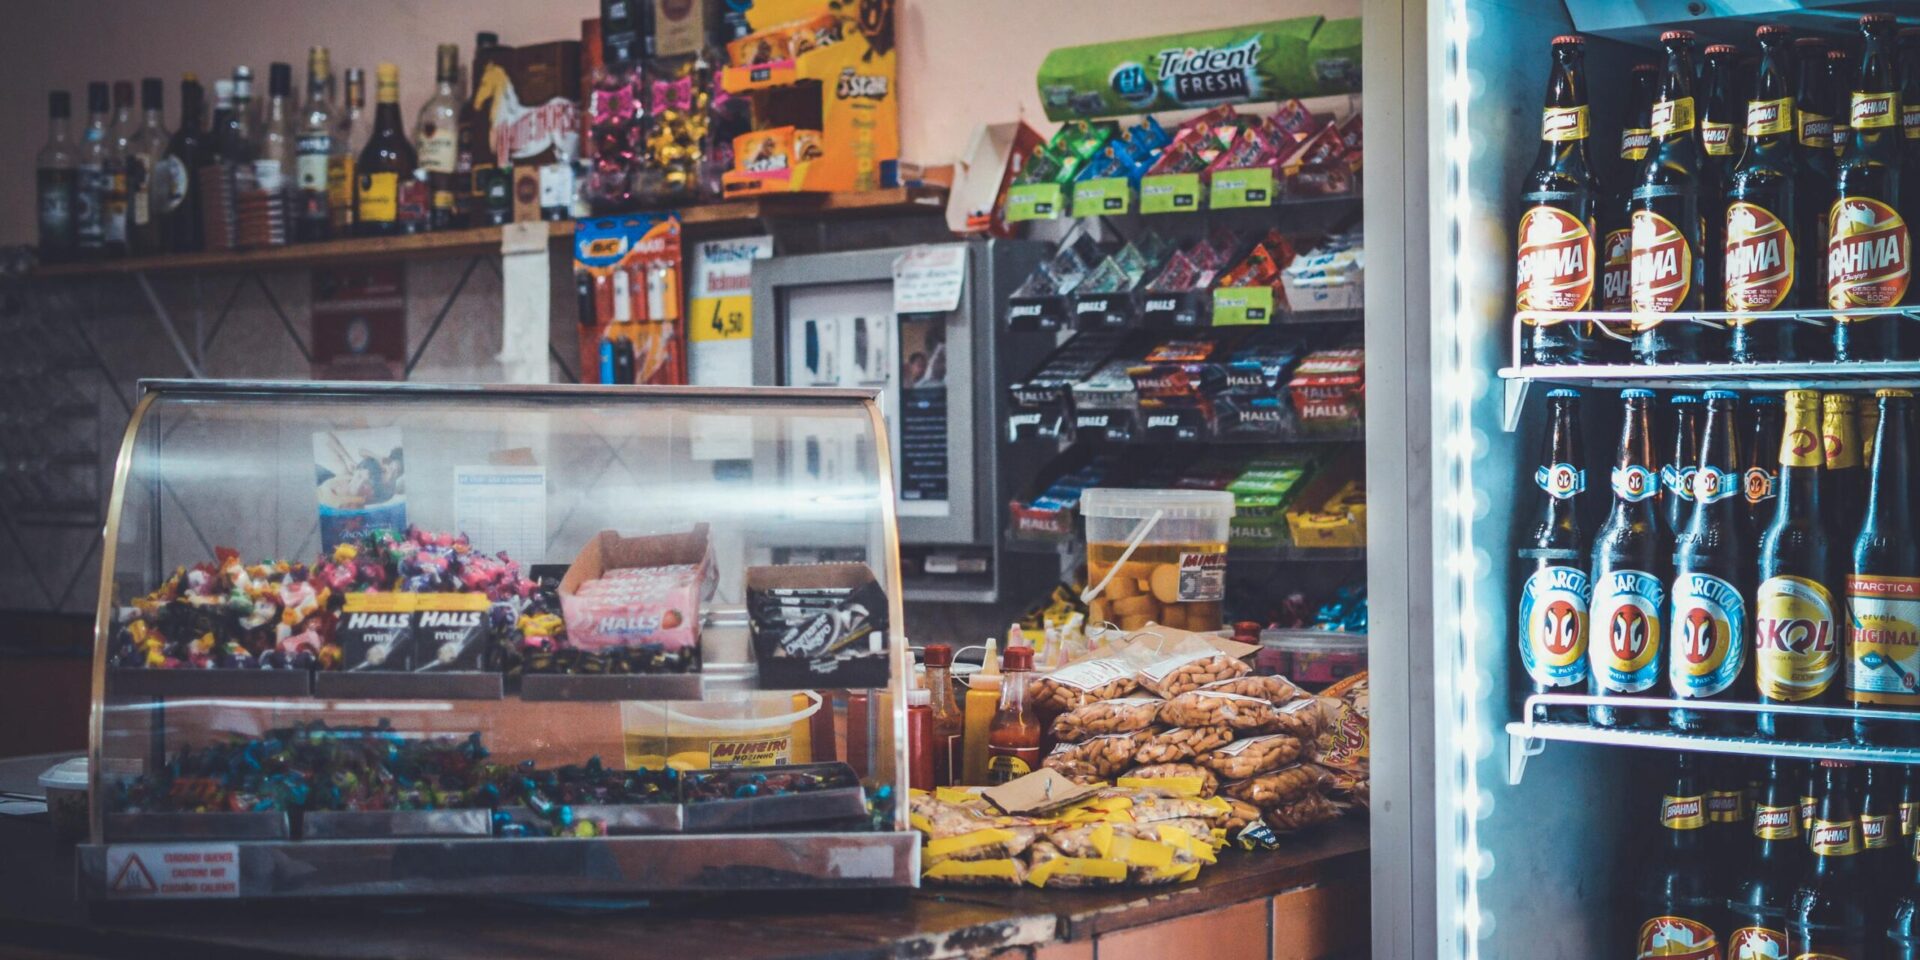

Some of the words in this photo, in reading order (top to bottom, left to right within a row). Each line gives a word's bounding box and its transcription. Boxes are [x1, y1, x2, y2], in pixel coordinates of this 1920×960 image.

[1159, 41, 1261, 80] Trident
[1180, 73, 1243, 95] FRESH
[1226, 375, 1263, 387] HALLS
[1239, 410, 1281, 423] HALLS
[1303, 404, 1348, 419] HALLS
[1229, 526, 1273, 539] HALLS
[1527, 569, 1592, 605] AARCTICA
[1848, 580, 1914, 593] ANTARCTICA
[348, 612, 410, 630] HALLS
[419, 611, 481, 628] HALLS
[599, 616, 660, 633] HALLS
[363, 631, 393, 643] mini
[434, 630, 464, 641] mini
[1756, 618, 1835, 656] SKOL
[1667, 802, 1699, 818] BRAHMA
[1757, 812, 1789, 827] BRAHMA
